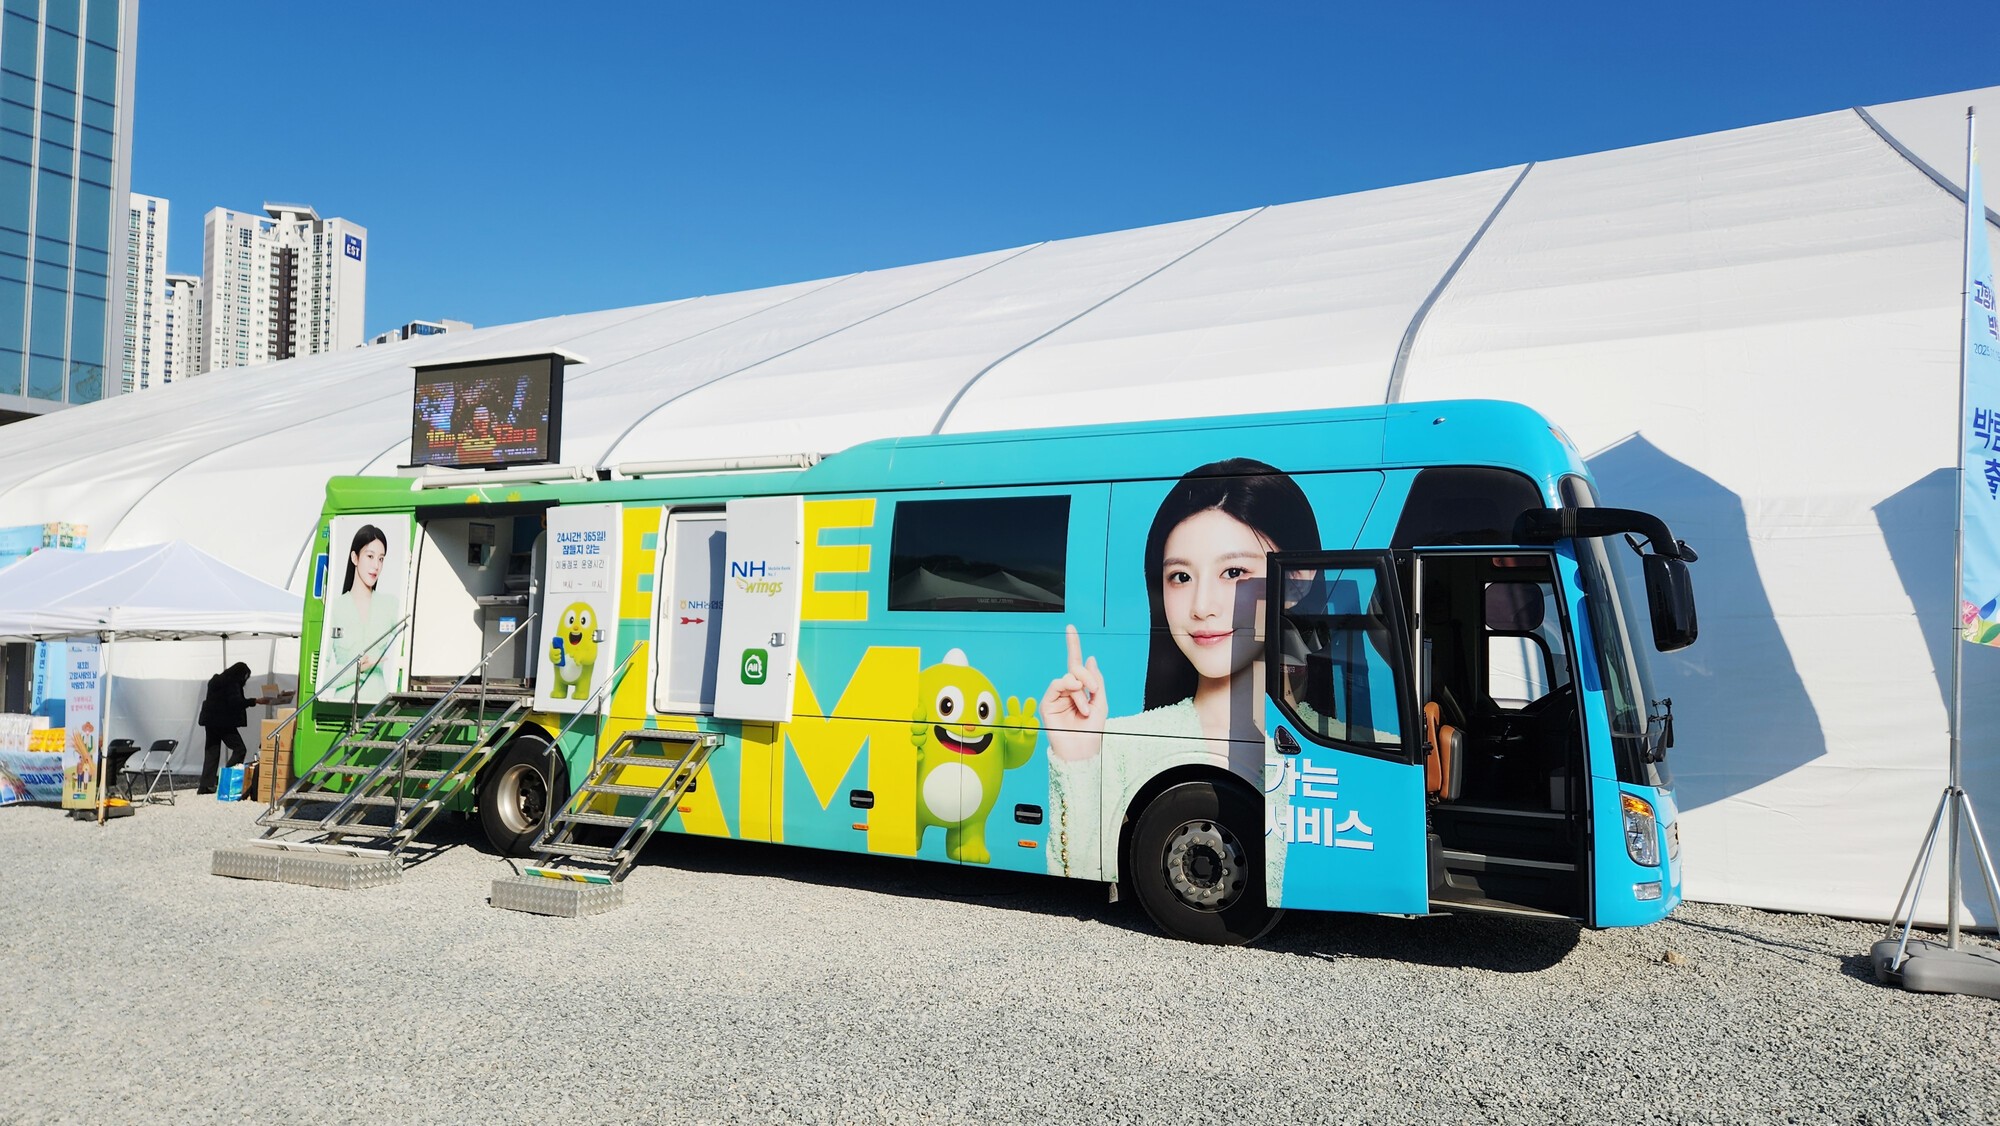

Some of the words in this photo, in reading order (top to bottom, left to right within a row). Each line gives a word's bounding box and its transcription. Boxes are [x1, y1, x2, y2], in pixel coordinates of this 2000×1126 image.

[346, 243, 360, 258] EST
[557, 532, 581, 542] 24시간!
[584, 531, 606, 541] 365일!
[563, 545, 583, 555] 잠들지
[586, 544, 600, 554] 않는
[556, 561, 578, 569] 이동점포
[582, 560, 605, 569] 운영시간
[731, 560, 766, 577] NH
[746, 578, 783, 597] wings
[1265, 758, 1339, 799] 가는
[1265, 804, 1374, 850] 서비스
